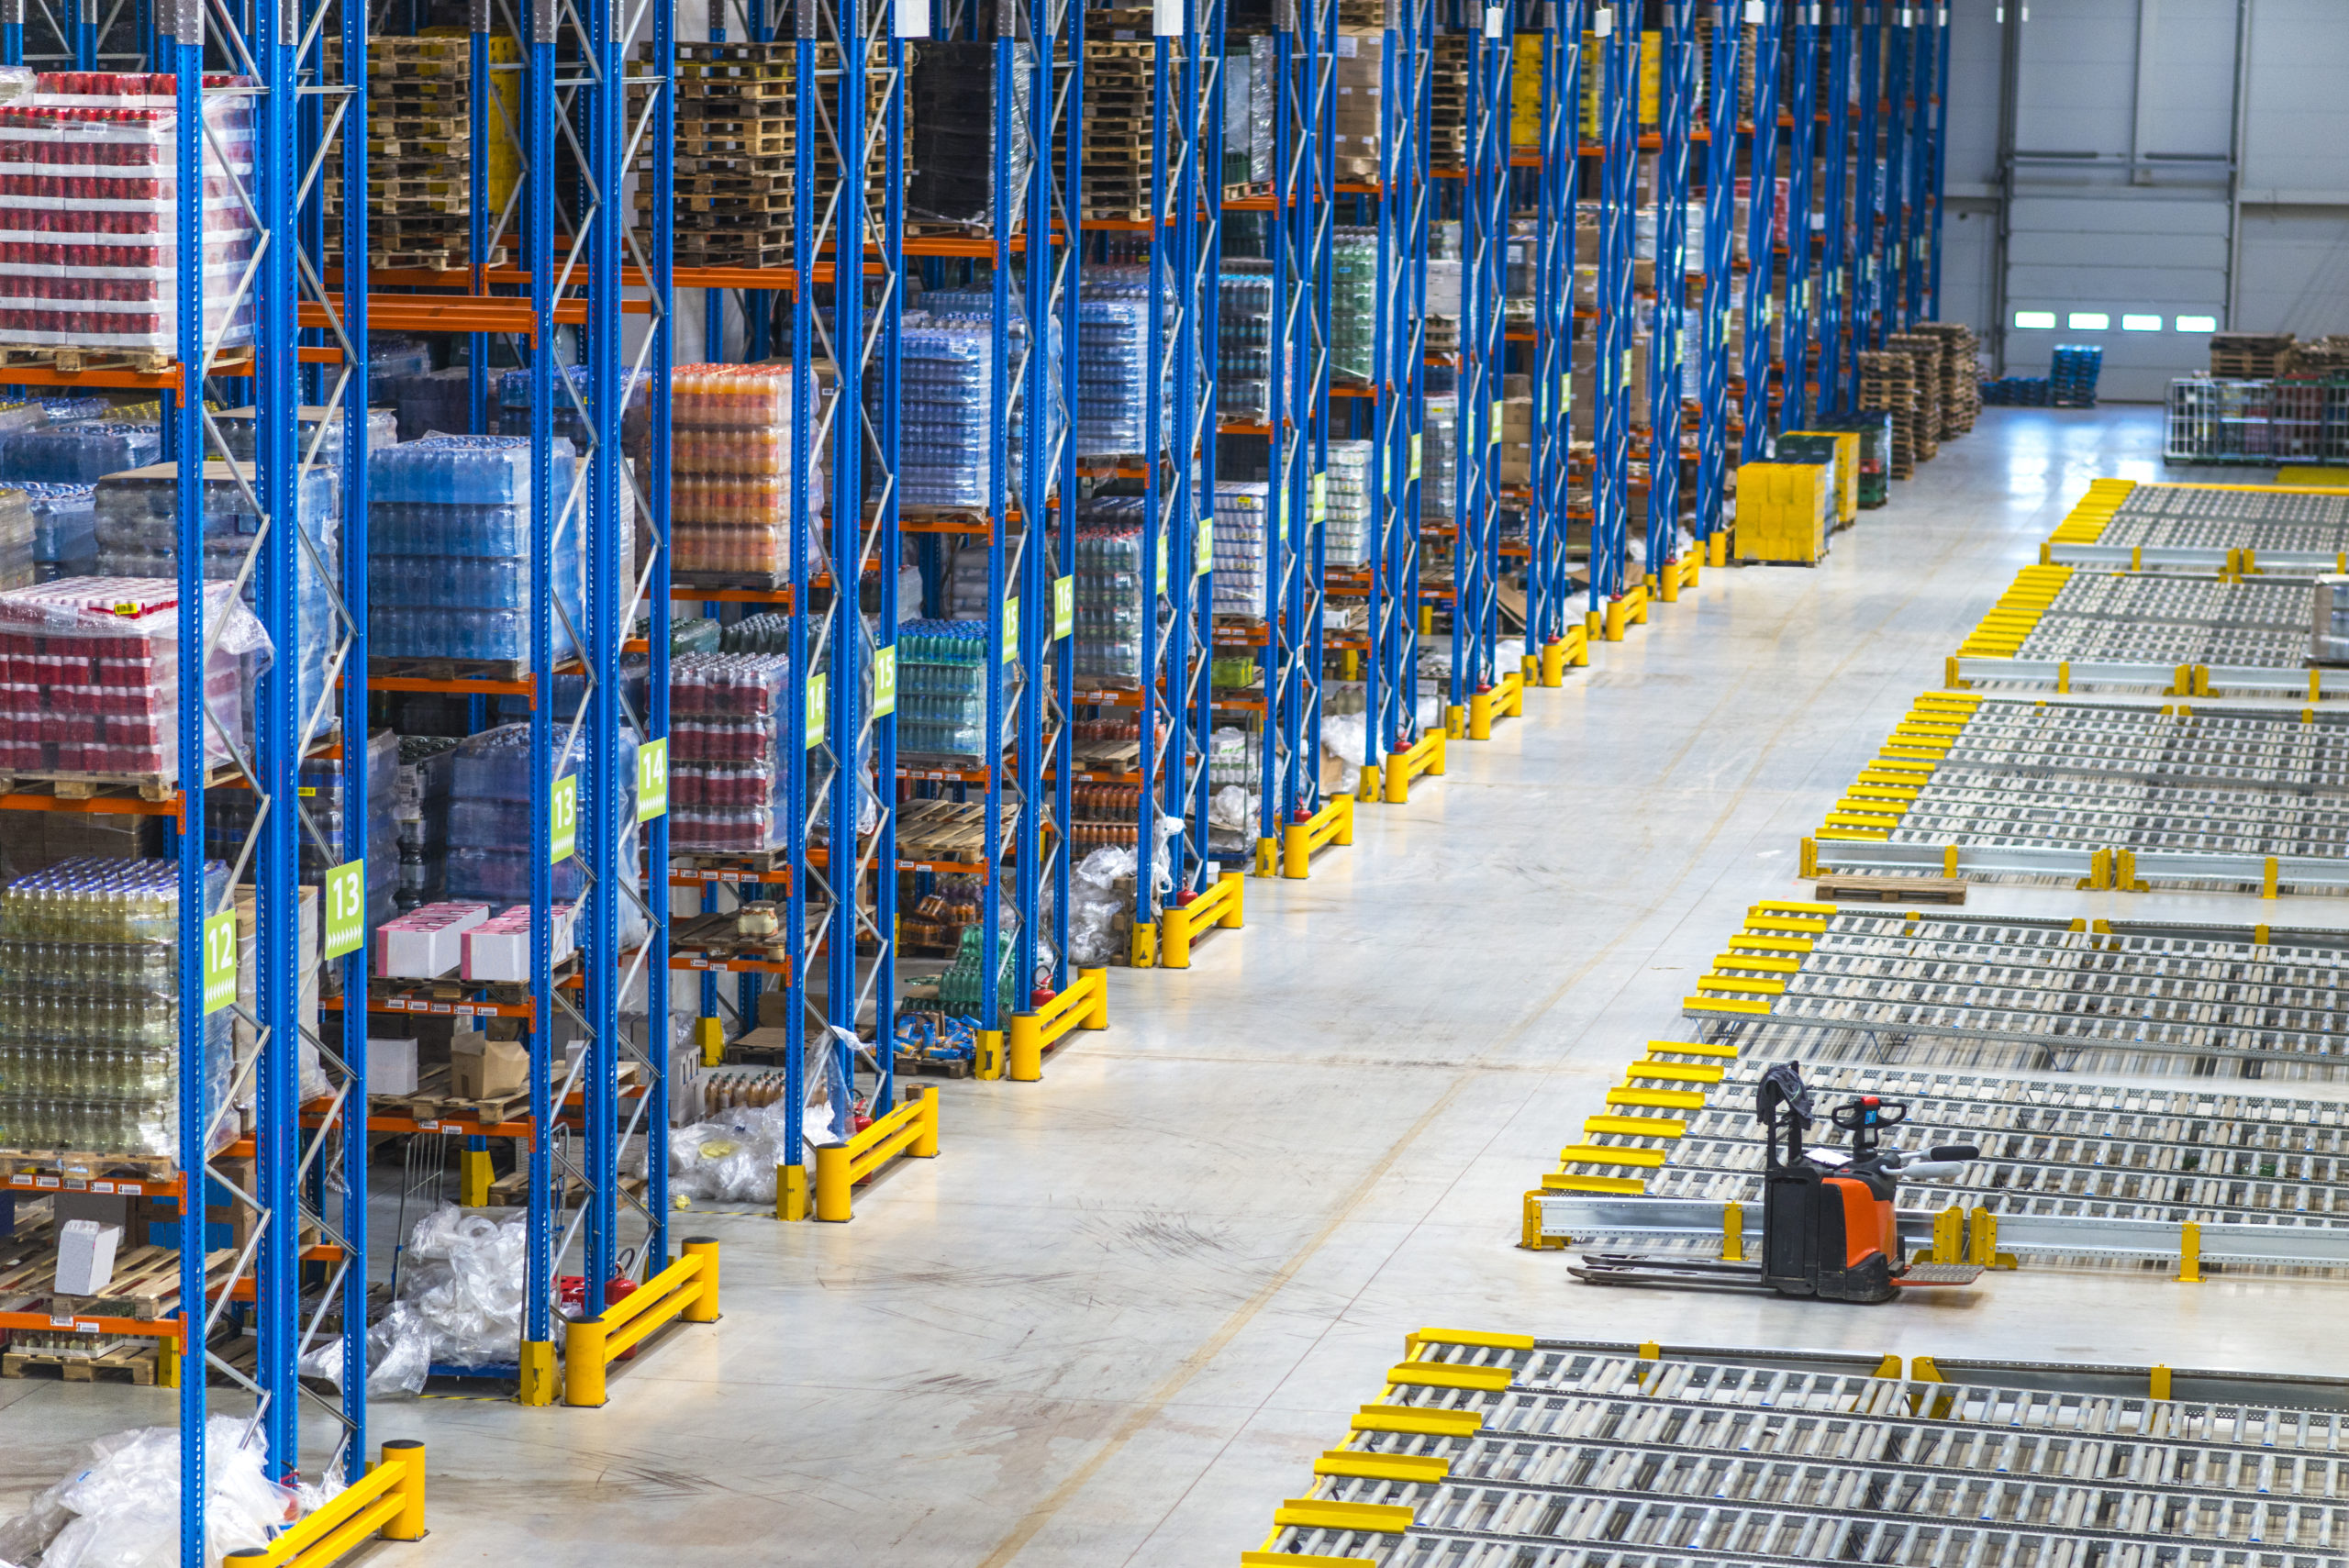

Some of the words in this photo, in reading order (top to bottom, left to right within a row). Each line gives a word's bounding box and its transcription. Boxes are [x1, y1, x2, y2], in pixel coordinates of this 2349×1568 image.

[1202, 525, 1212, 552] 17
[1058, 584, 1072, 615] 16
[1005, 605, 1017, 638] 15
[878, 654, 894, 690] 15
[808, 682, 824, 719] 14
[643, 748, 664, 789] 14
[554, 786, 573, 828] 13
[333, 872, 360, 920] 13
[208, 922, 233, 973] 12
